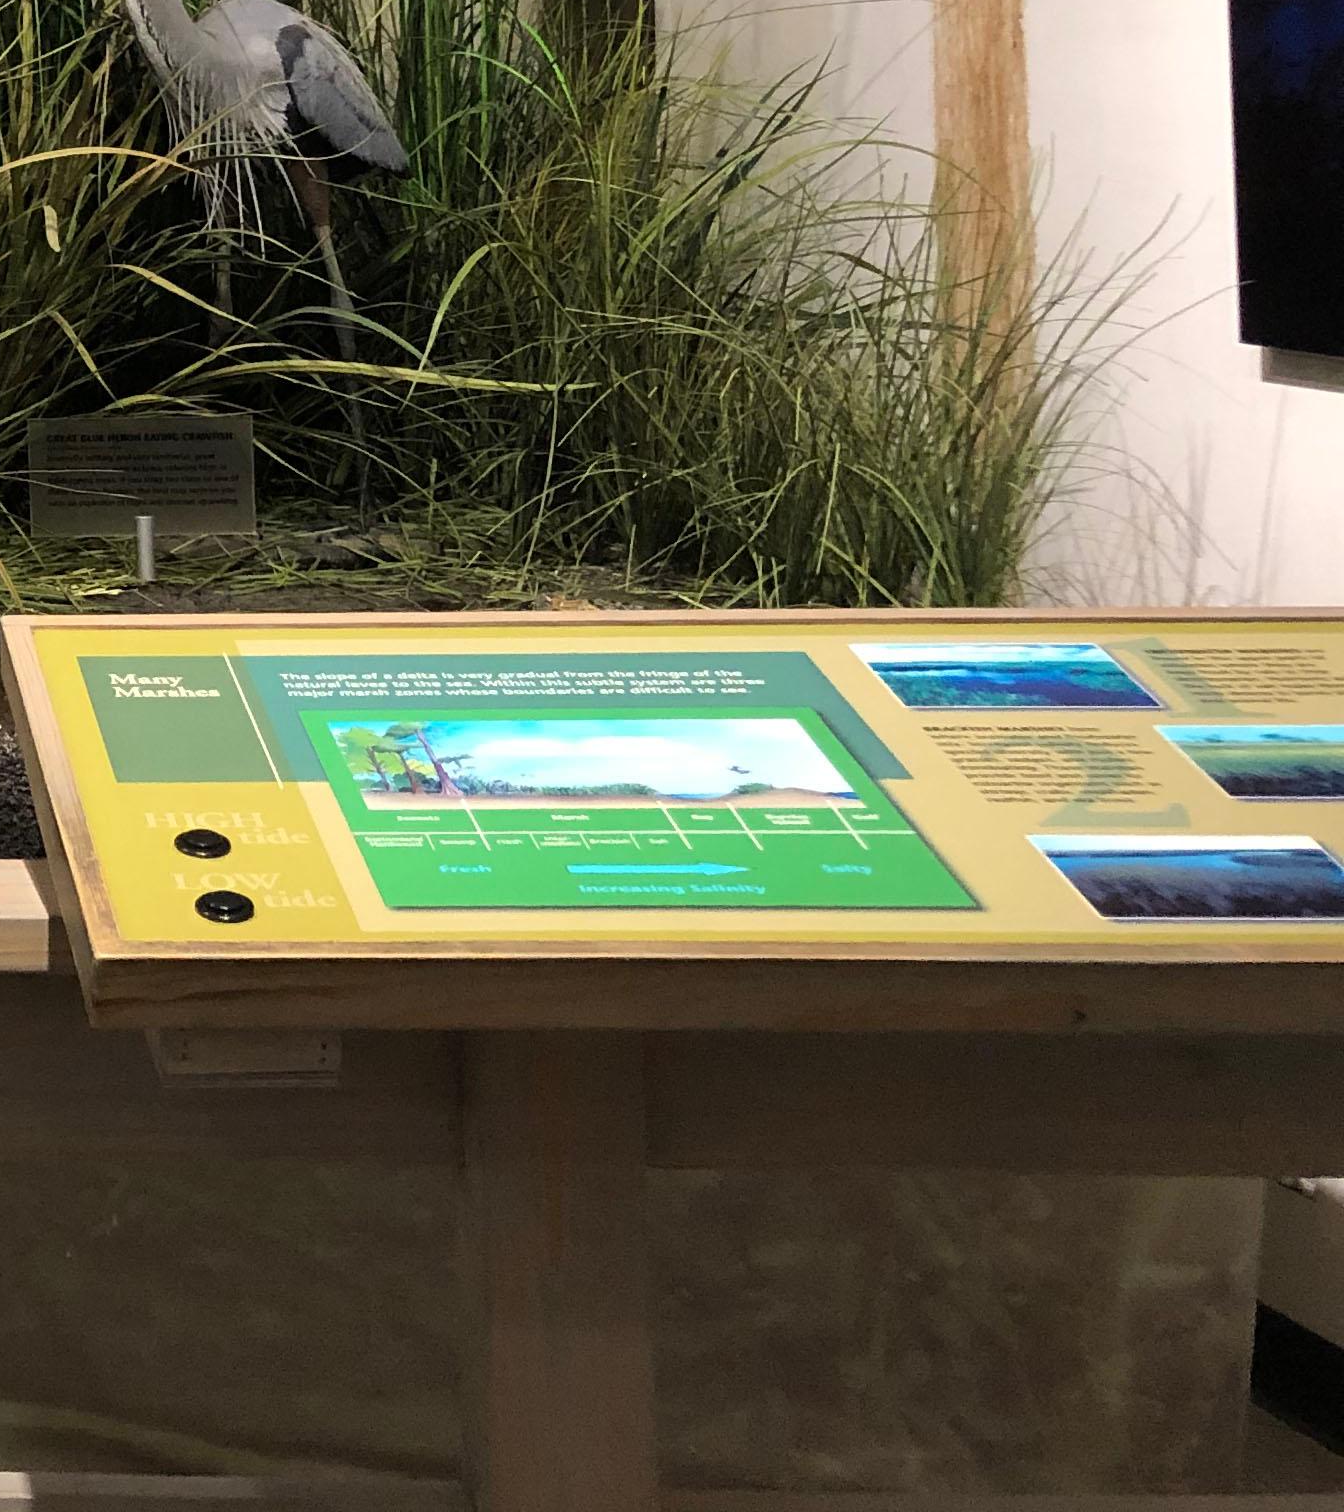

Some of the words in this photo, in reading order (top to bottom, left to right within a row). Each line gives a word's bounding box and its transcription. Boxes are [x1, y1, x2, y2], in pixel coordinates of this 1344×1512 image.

[109, 673, 184, 688] Many
[114, 686, 220, 699] Marshes
[986, 734, 1191, 828] 2
[144, 812, 267, 829] HIGH
[237, 828, 310, 844] tide
[439, 863, 492, 873] Fresh
[172, 872, 280, 890] LOW
[579, 884, 685, 895] Increasing
[690, 884, 766, 895] Salinity
[264, 889, 336, 908] tide
